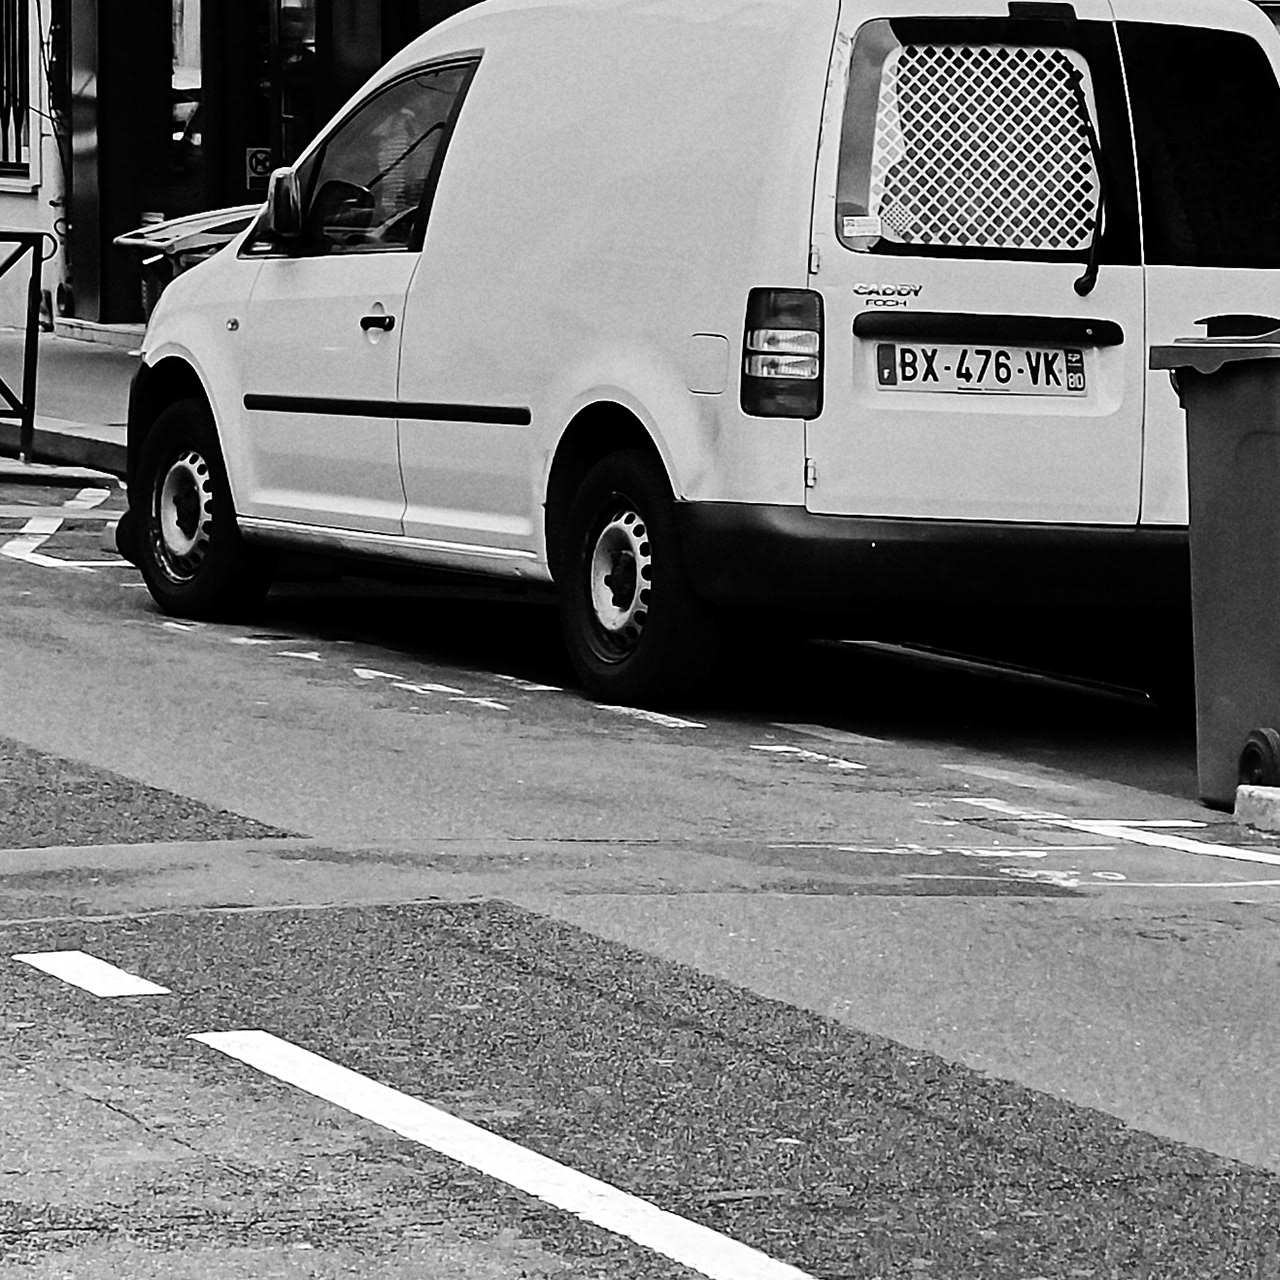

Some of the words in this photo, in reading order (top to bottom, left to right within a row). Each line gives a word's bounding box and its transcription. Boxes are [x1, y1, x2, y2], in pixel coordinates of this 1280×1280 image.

[853, 282, 923, 297] CADDY
[900, 348, 1062, 387] BX-476-VK
[1067, 372, 1084, 388] 80
